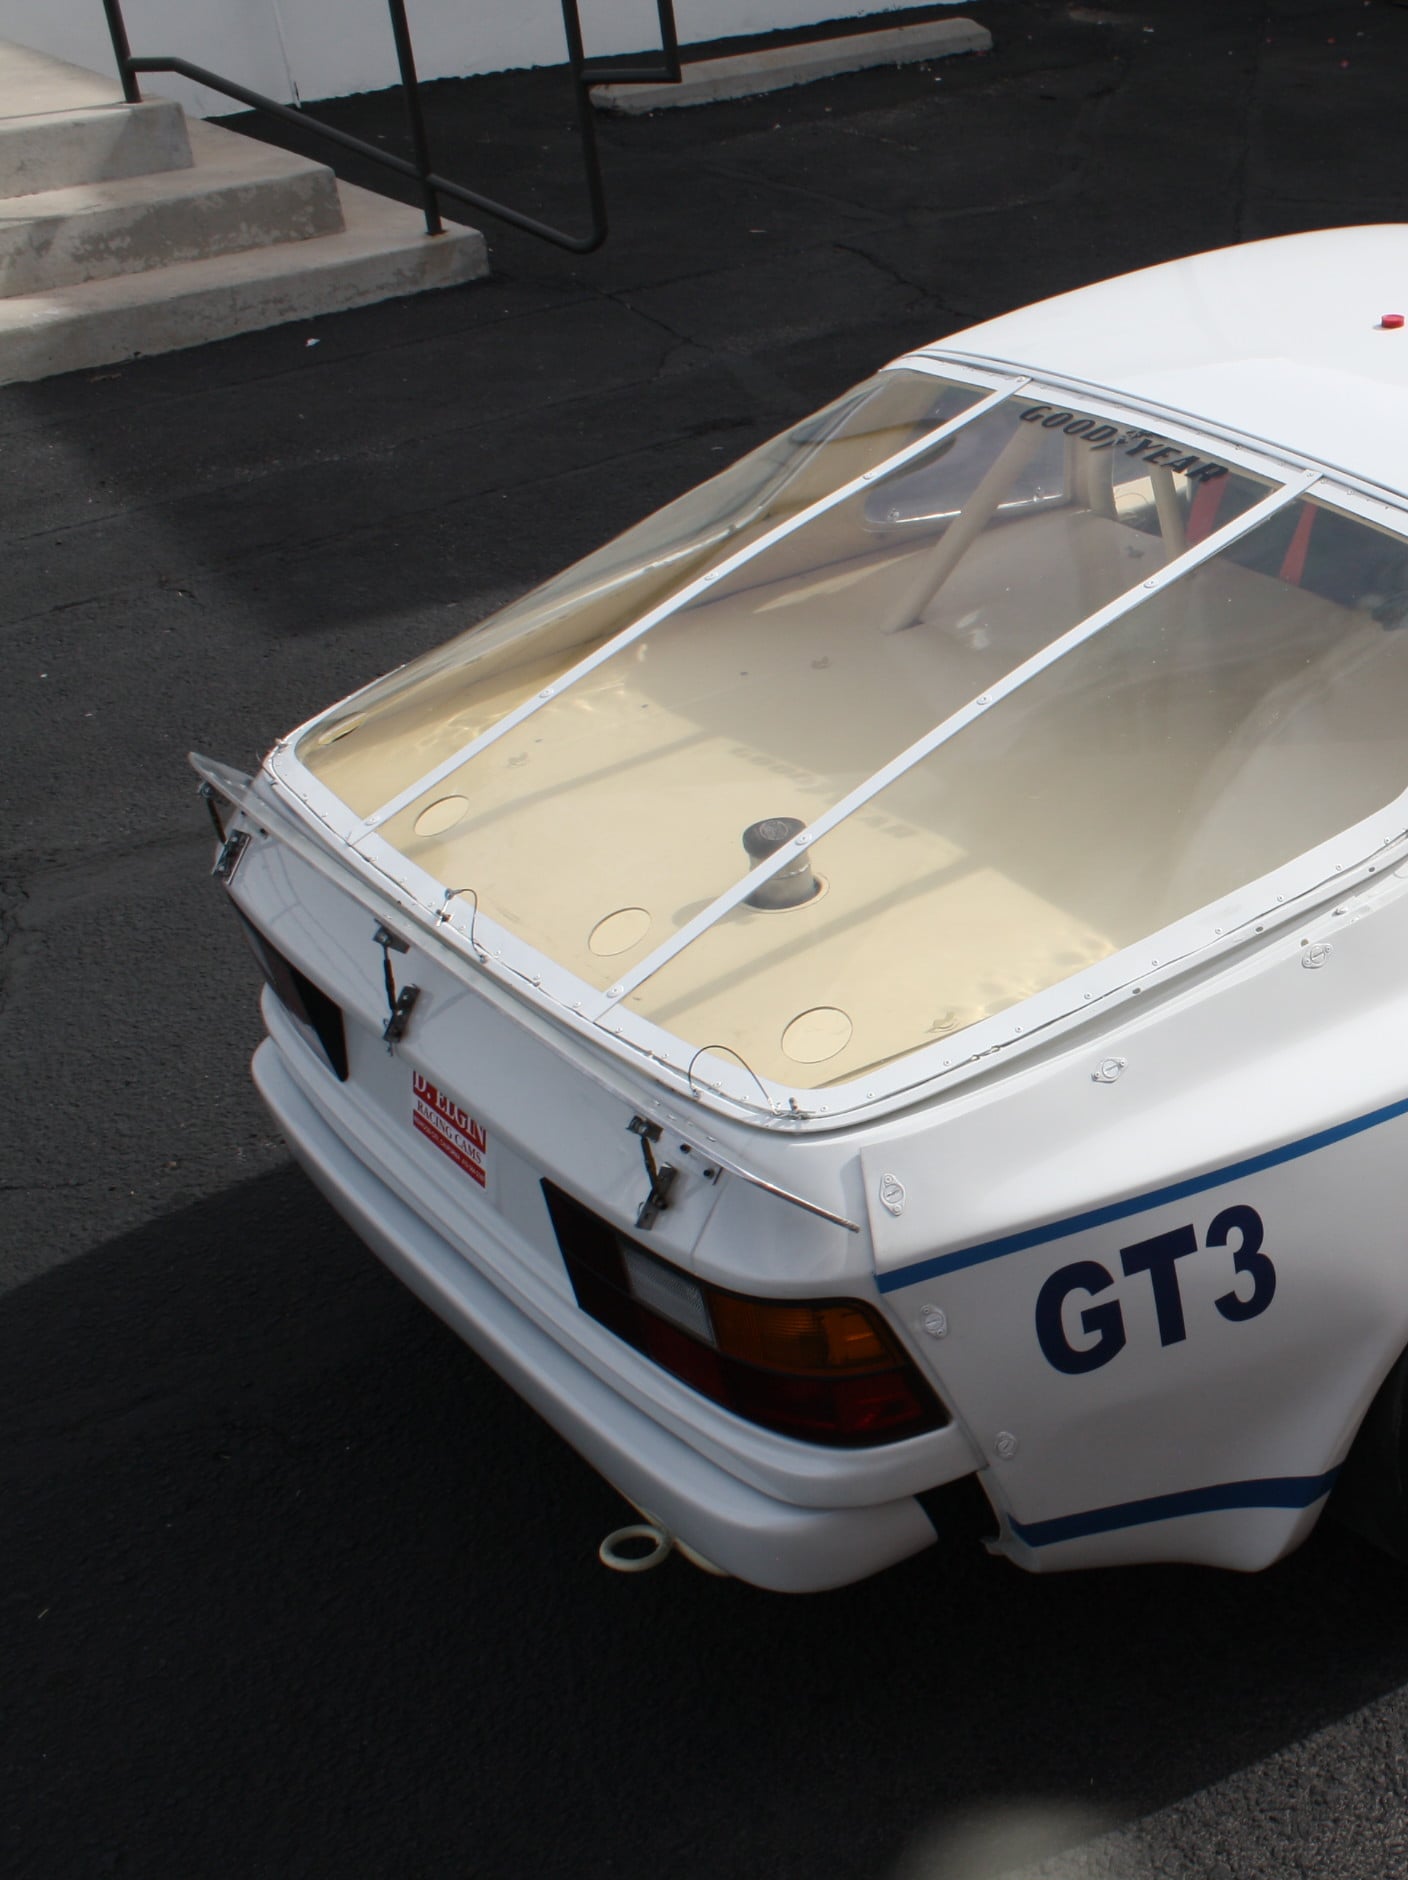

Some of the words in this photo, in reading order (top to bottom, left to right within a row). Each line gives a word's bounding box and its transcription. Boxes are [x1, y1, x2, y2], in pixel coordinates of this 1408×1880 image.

[417, 1100, 453, 1139] RACING
[455, 1133, 482, 1164] CAMS
[436, 1089, 486, 1150] ELGIN
[1035, 1204, 1276, 1375] GT3
